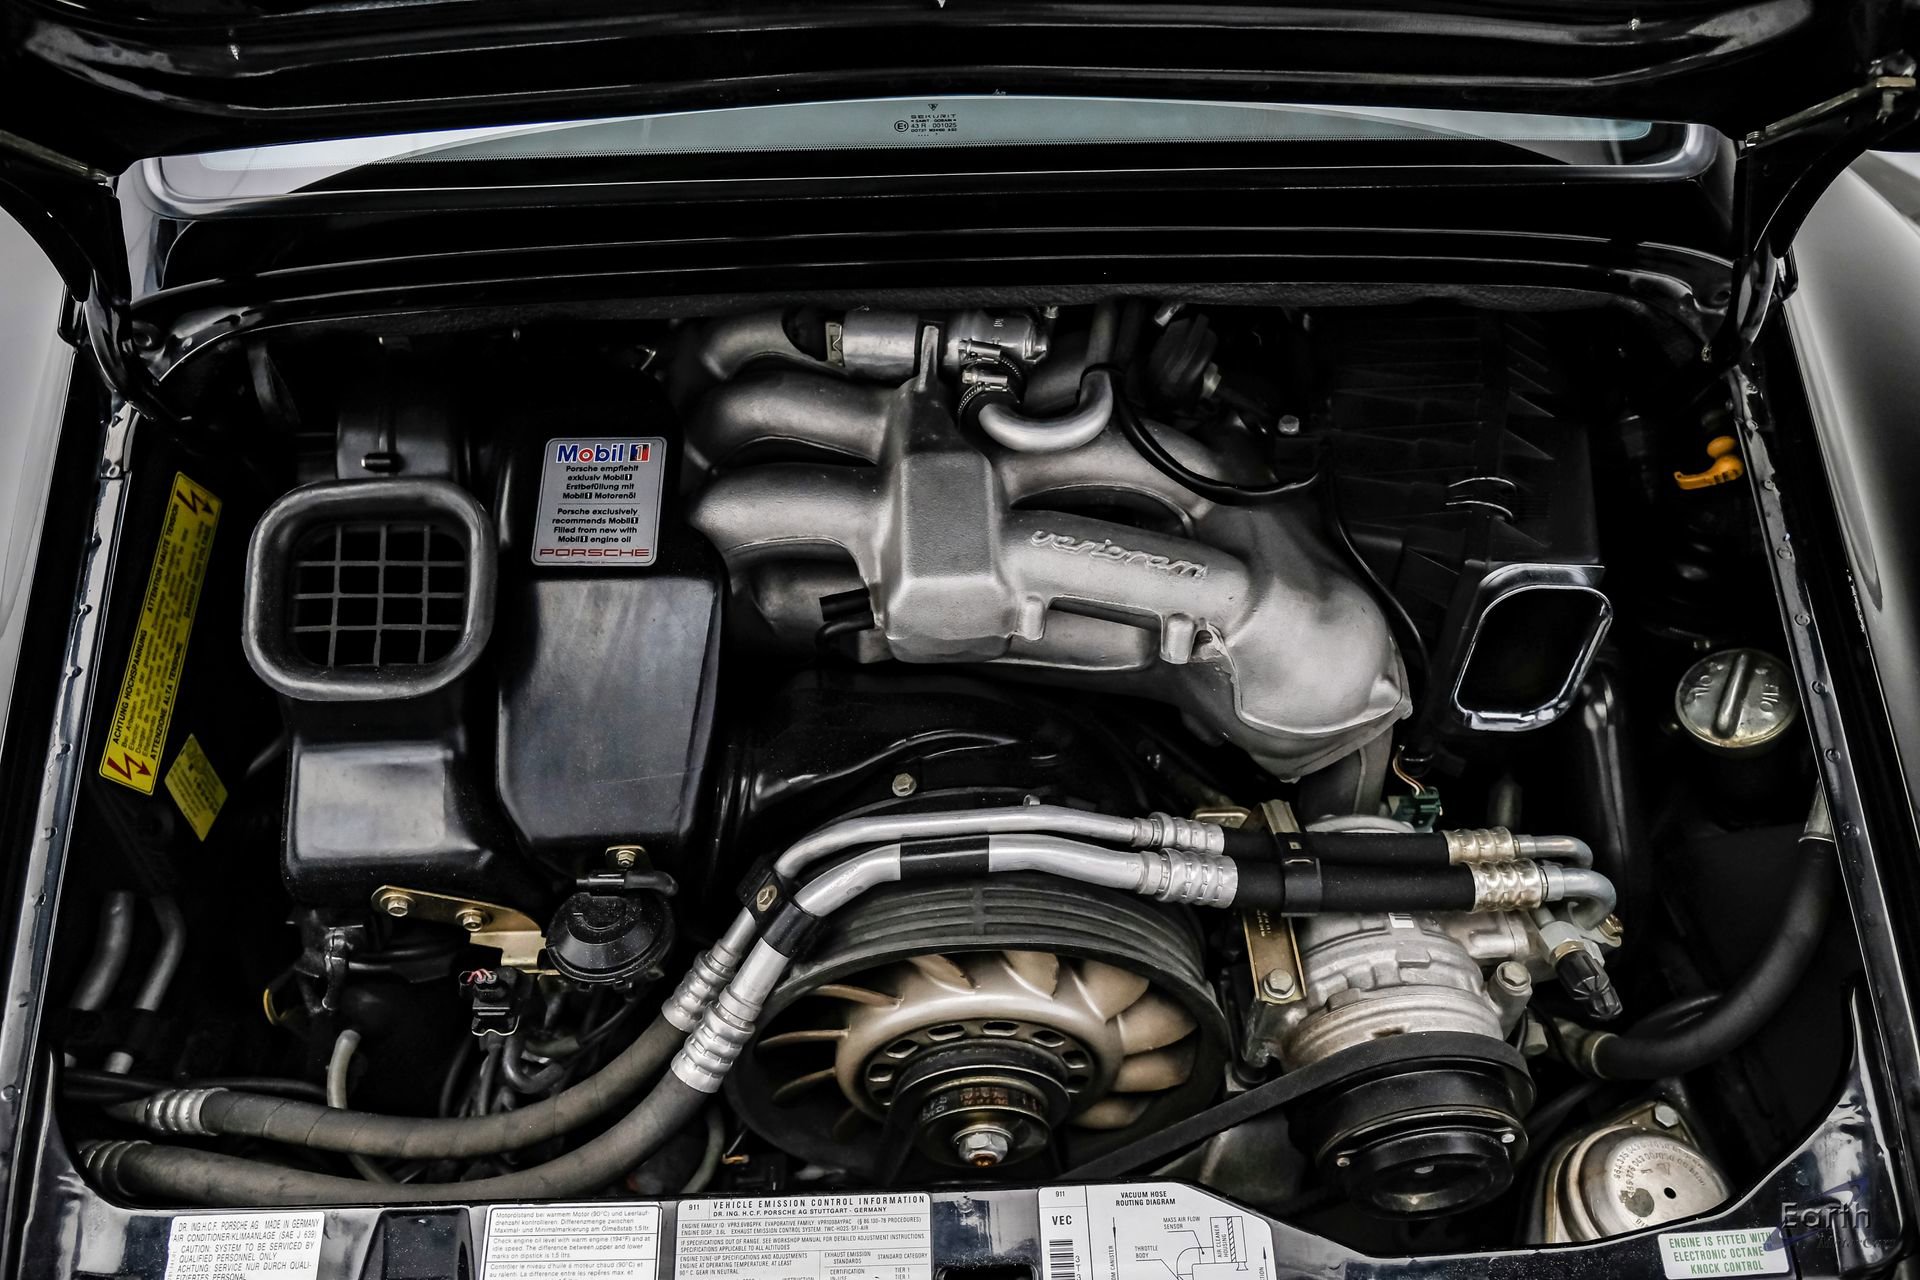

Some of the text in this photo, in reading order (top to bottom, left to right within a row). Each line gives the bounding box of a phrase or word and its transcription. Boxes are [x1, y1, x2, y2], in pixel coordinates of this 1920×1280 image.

[556, 444, 624, 463] Mobil
[600, 465, 640, 474] empfiehlt
[566, 483, 620, 491] Erstbefüllung
[594, 492, 637, 500] Motorenöl
[592, 508, 639, 516] exclusively
[553, 526, 576, 534] Filled
[577, 526, 598, 534] from
[619, 526, 638, 534] with
[539, 548, 650, 557] PORSCHE
[113, 629, 148, 745] ACHTUNG HOCHSPANNUNG
[149, 707, 168, 761] ATTENZIONE
[162, 684, 174, 706] ALTA
[1120, 1191, 1148, 1199] VACUUM
[713, 1195, 925, 1209] VEHICLE EMISSION CONTROL INFORMATION
[1115, 1198, 1176, 1207] ROUTING DIAGRAM
[809, 1207, 848, 1215] STUTTGART
[854, 1206, 887, 1214] GERMANY
[221, 1218, 320, 1231] PORSCHE AG MADE IN GERMANY
[1051, 1215, 1072, 1226] VEC
[173, 1233, 184, 1242] AIR
[1669, 1237, 1701, 1249] ENGINE
[1704, 1236, 1714, 1247] IS
[1716, 1234, 1747, 1245] FITTED
[215, 1241, 315, 1253] SYSTEM TO BE SERVICED BY
[1221, 1233, 1229, 1258] HOUSING
[179, 1251, 277, 1263] QUALIFIED PERSONNEL ONLY
[1673, 1246, 1764, 1262] ELECTRONIC OCTANE
[214, 1262, 243, 1272] SERVICE
[246, 1262, 260, 1271] NUR
[263, 1261, 287, 1271] DURCH
[1690, 1260, 1764, 1275] KNOCK CONTROL
